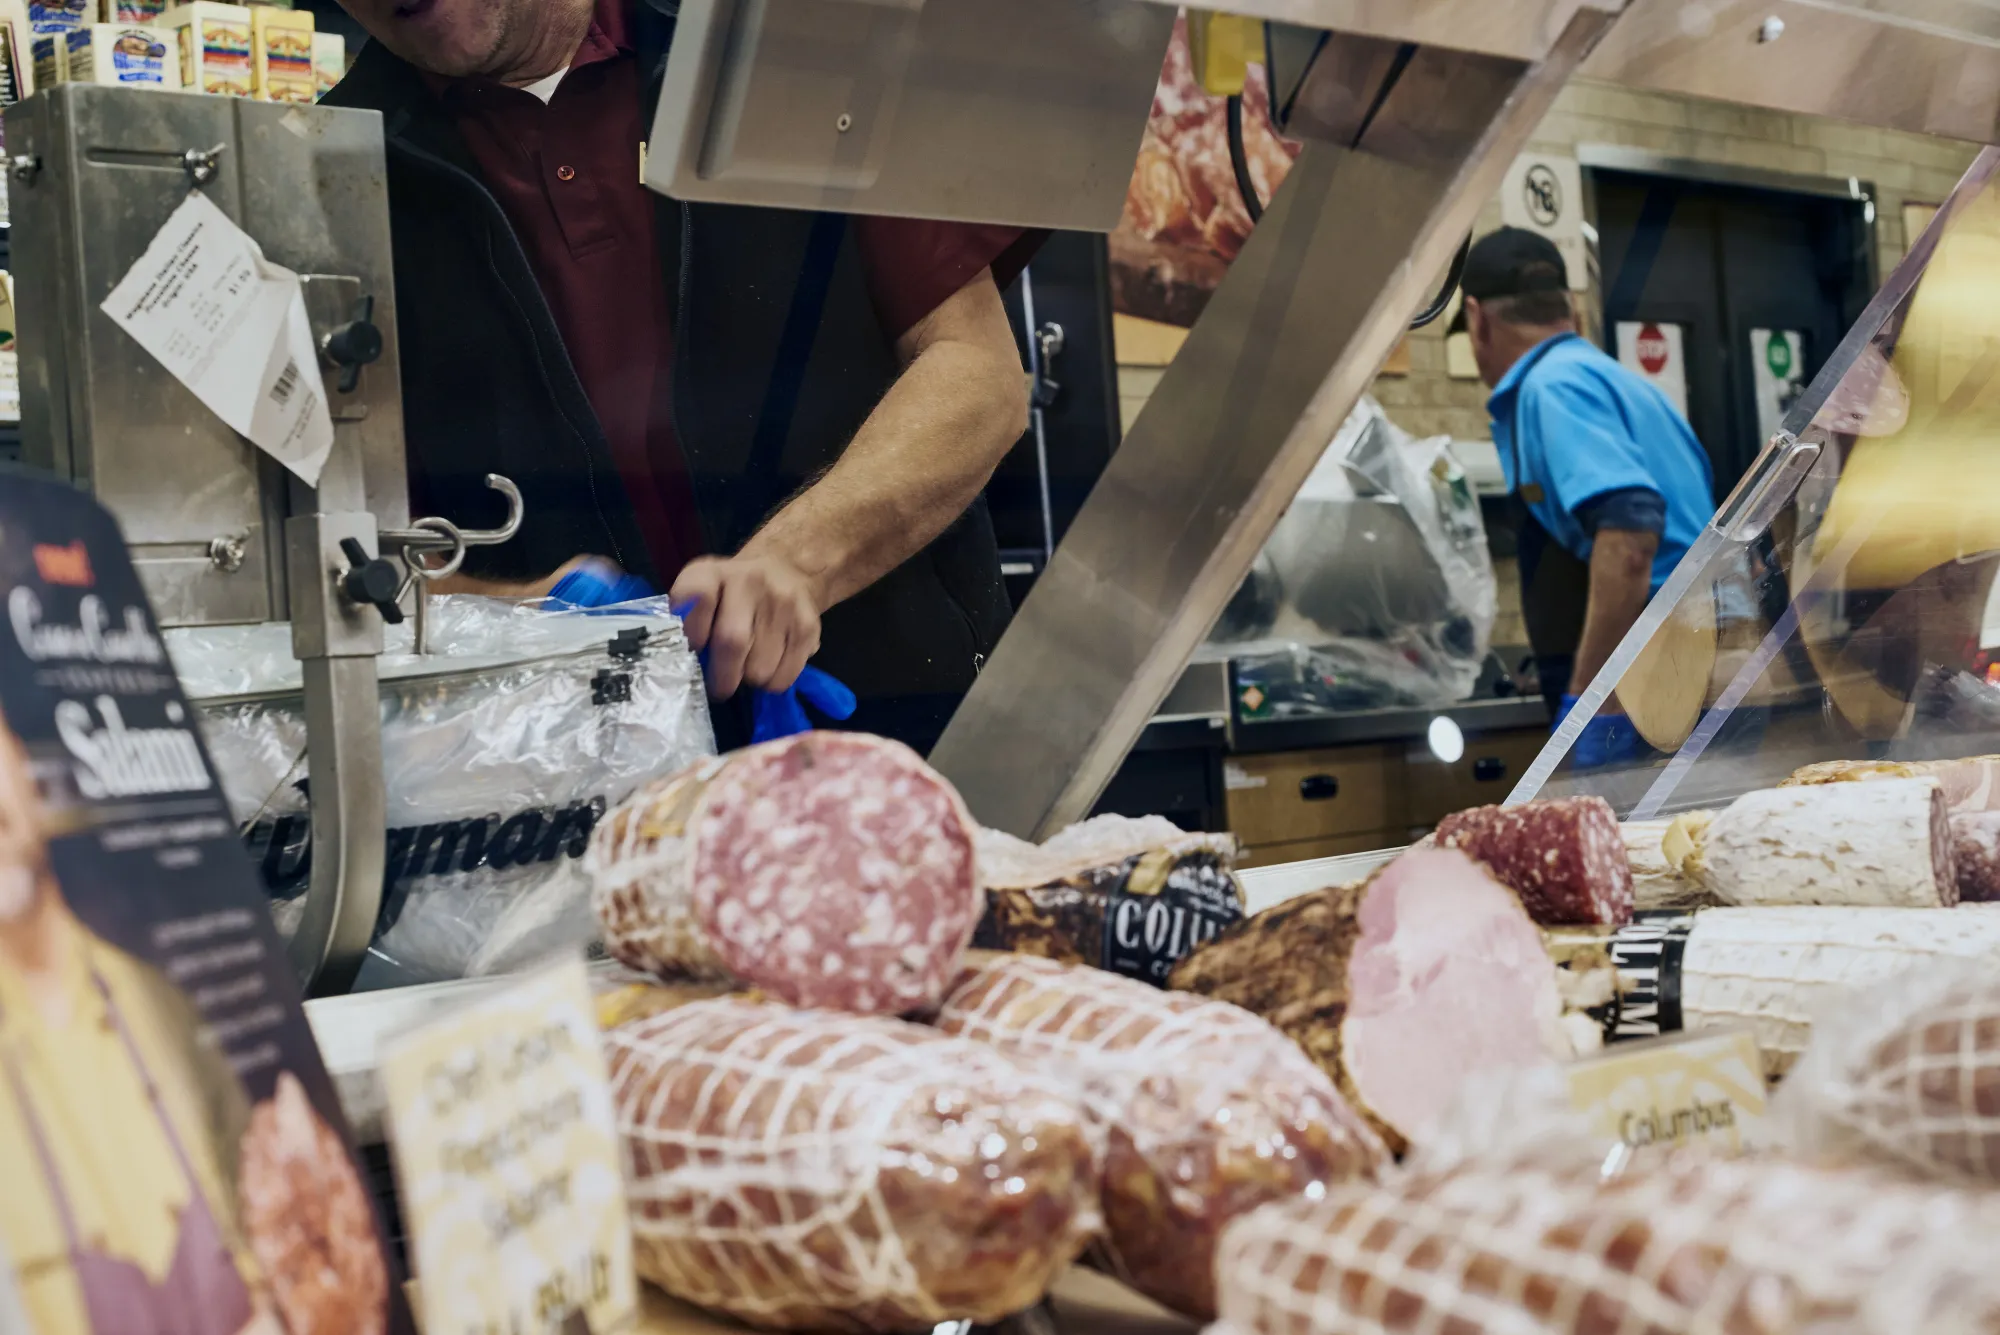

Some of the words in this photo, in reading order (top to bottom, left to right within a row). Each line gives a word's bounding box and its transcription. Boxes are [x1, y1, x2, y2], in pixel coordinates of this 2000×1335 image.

[1637, 338, 1668, 359] STOP
[55, 695, 212, 798] Salami
[1619, 1098, 1735, 1149] Columbus
